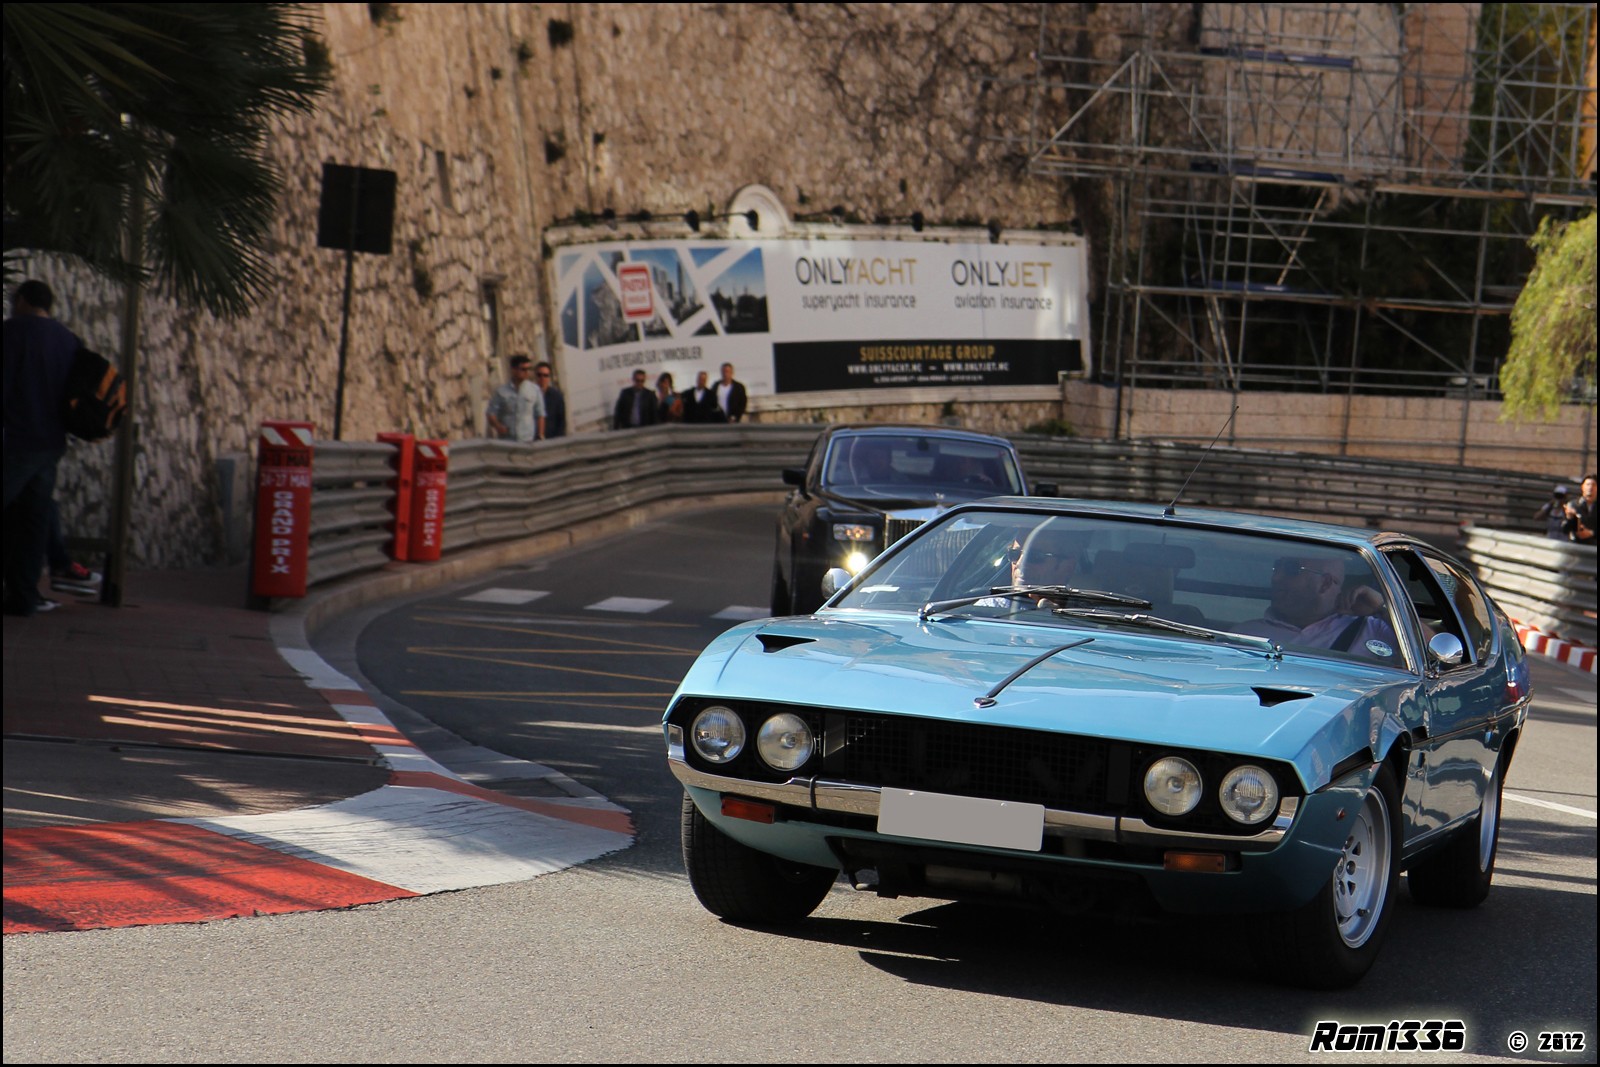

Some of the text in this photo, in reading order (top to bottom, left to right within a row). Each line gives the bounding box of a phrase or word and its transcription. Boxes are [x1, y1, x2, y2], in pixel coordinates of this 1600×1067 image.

[795, 257, 918, 286] ONLYYACHT
[951, 260, 1053, 288] ONLYJET
[802, 292, 917, 312] superyacht insurance
[954, 293, 1053, 311] aviation insurance
[859, 344, 996, 362] SUISSCOURTAGE GROUP
[289, 473, 310, 488] MAI
[271, 490, 293, 574] GRAND PRIX
